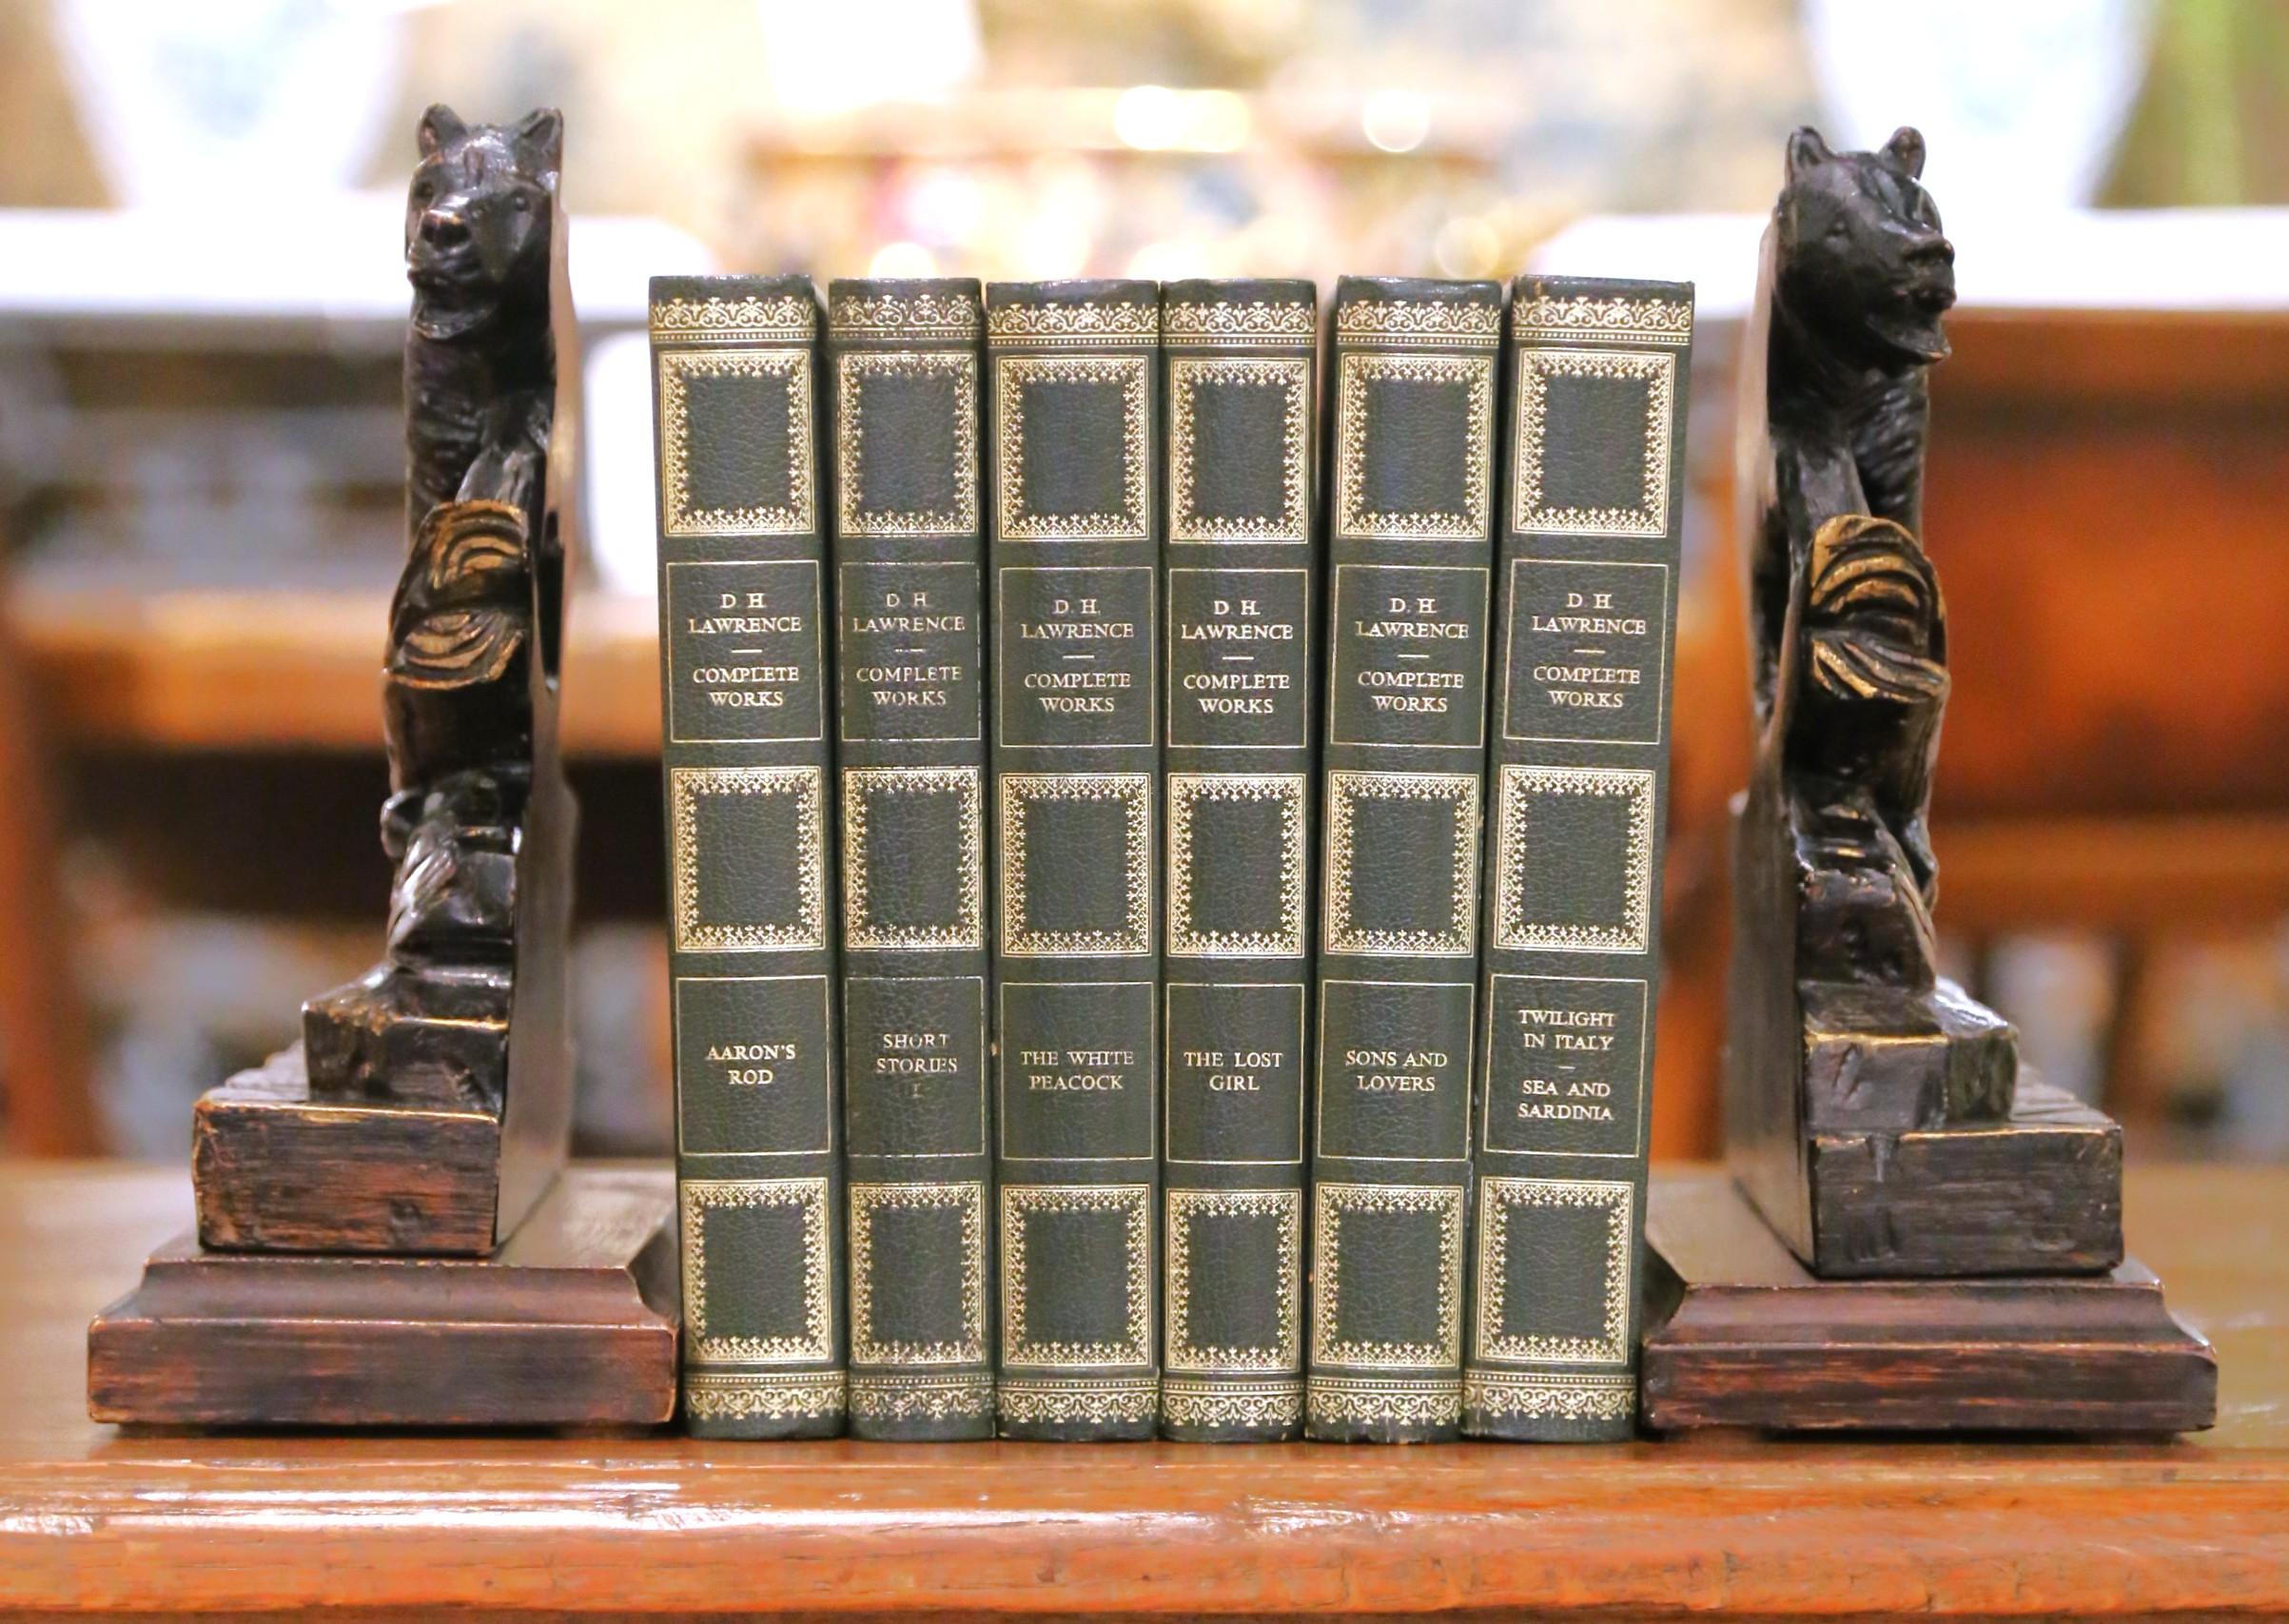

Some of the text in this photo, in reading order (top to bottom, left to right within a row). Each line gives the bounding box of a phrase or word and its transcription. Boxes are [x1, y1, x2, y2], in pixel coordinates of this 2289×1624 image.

[689, 616, 802, 635] LAWRENCE
[853, 616, 966, 633] LAWRENCE
[1021, 623, 1135, 639] LAWRENCE
[1181, 623, 1294, 640] LAWRENCE
[1355, 620, 1470, 639] LAWRENCE
[1532, 616, 1647, 636] LAWRENCE
[693, 666, 799, 684] COMPLETE
[856, 666, 963, 682] COMPLETE
[1024, 672, 1131, 689] COMPLETE
[1183, 674, 1290, 690] COMPLETE
[1358, 671, 1465, 689] COMPLETE
[1533, 666, 1641, 685] COMPLETE
[709, 691, 784, 708] WORKS
[871, 690, 947, 707] WORKS
[1038, 696, 1115, 714] WORKS
[1198, 697, 1274, 714] WORKS
[1371, 695, 1448, 713] WORKS
[1547, 690, 1624, 709] WORKS
[1517, 1008, 1614, 1027] TWILIGHT
[883, 1033, 949, 1049] SHORT
[1523, 1032, 1614, 1051] IN ITALY
[707, 1044, 796, 1061] AARON'S
[1020, 1050, 1134, 1066] THE WHITE
[1183, 1051, 1283, 1068] THE LOST
[1345, 1049, 1448, 1067] SONS AND
[876, 1057, 958, 1074] STORIES
[728, 1068, 773, 1086] ROD
[1028, 1074, 1124, 1091] PEACOCK
[1209, 1074, 1261, 1091] GIRL
[1357, 1075, 1436, 1092] LOVERS
[1522, 1080, 1612, 1098] SEA AND
[1517, 1103, 1614, 1121] SARDINIA
